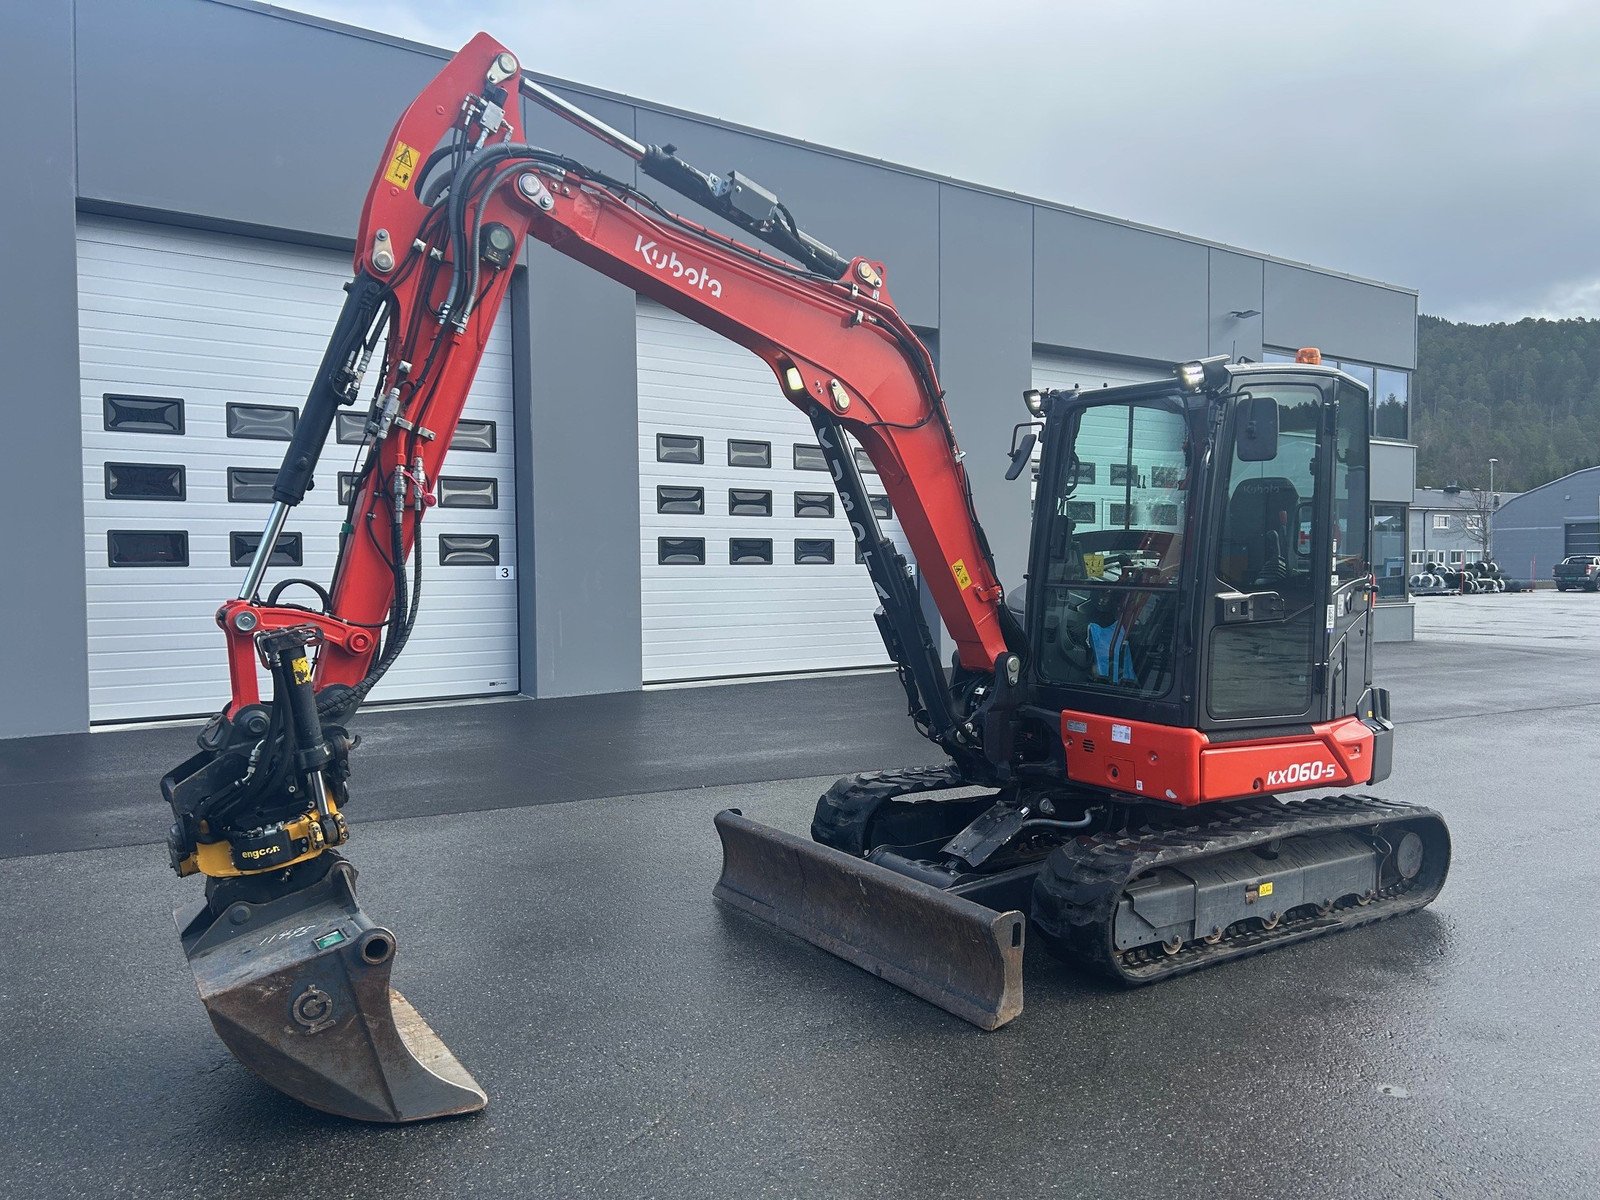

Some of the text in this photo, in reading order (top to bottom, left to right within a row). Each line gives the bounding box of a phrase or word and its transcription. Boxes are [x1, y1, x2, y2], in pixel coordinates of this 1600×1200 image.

[635, 234, 722, 298] Kubota
[501, 567, 509, 578] 3
[1267, 761, 1336, 785] KX060-5
[242, 845, 280, 859] engcon
